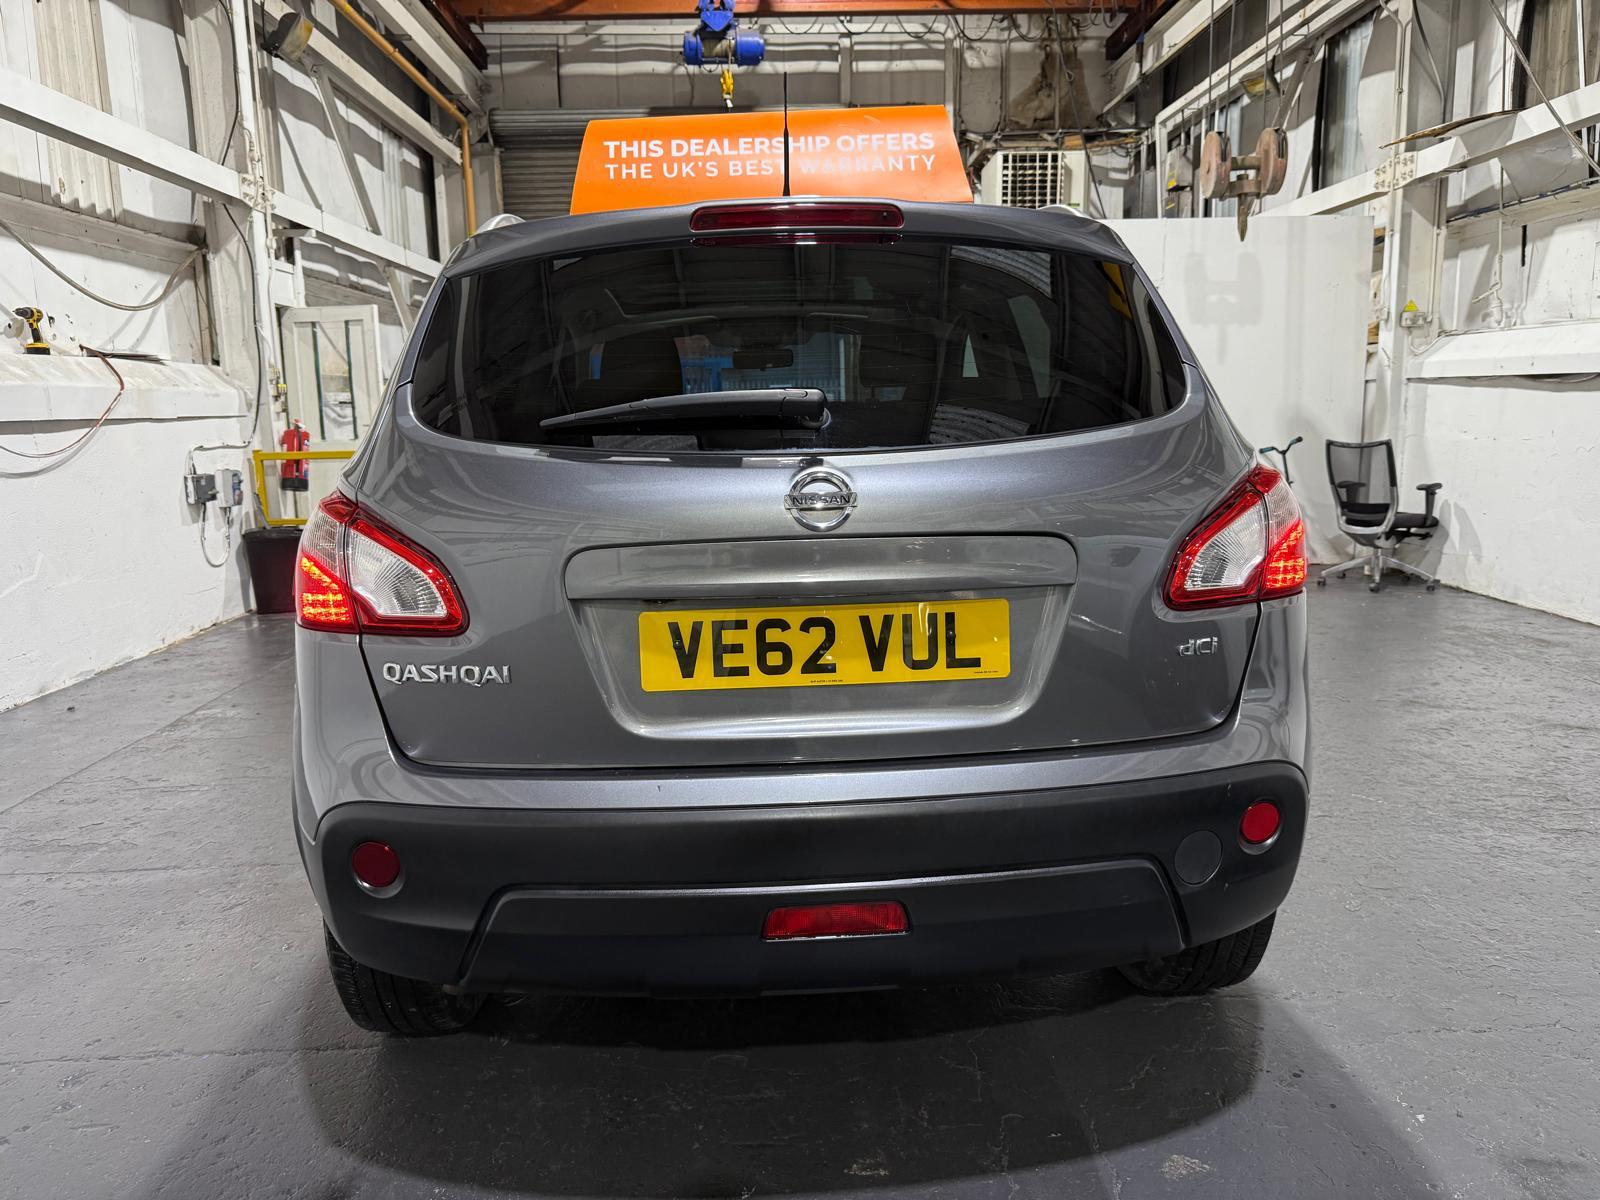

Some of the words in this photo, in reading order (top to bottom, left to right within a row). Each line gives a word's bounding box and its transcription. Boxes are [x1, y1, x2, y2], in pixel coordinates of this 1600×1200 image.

[603, 139, 664, 159] THIS
[671, 135, 830, 157] DEALERSHIP
[836, 132, 935, 152] OFFERS
[604, 163, 653, 180] THE
[662, 161, 719, 178] UK'S
[728, 159, 785, 177] BEST
[799, 154, 936, 174] WARRANTY
[791, 494, 852, 505] NISSAN
[667, 616, 837, 679] VE62
[858, 611, 982, 672] VUL
[382, 662, 512, 687] QASHQAI
